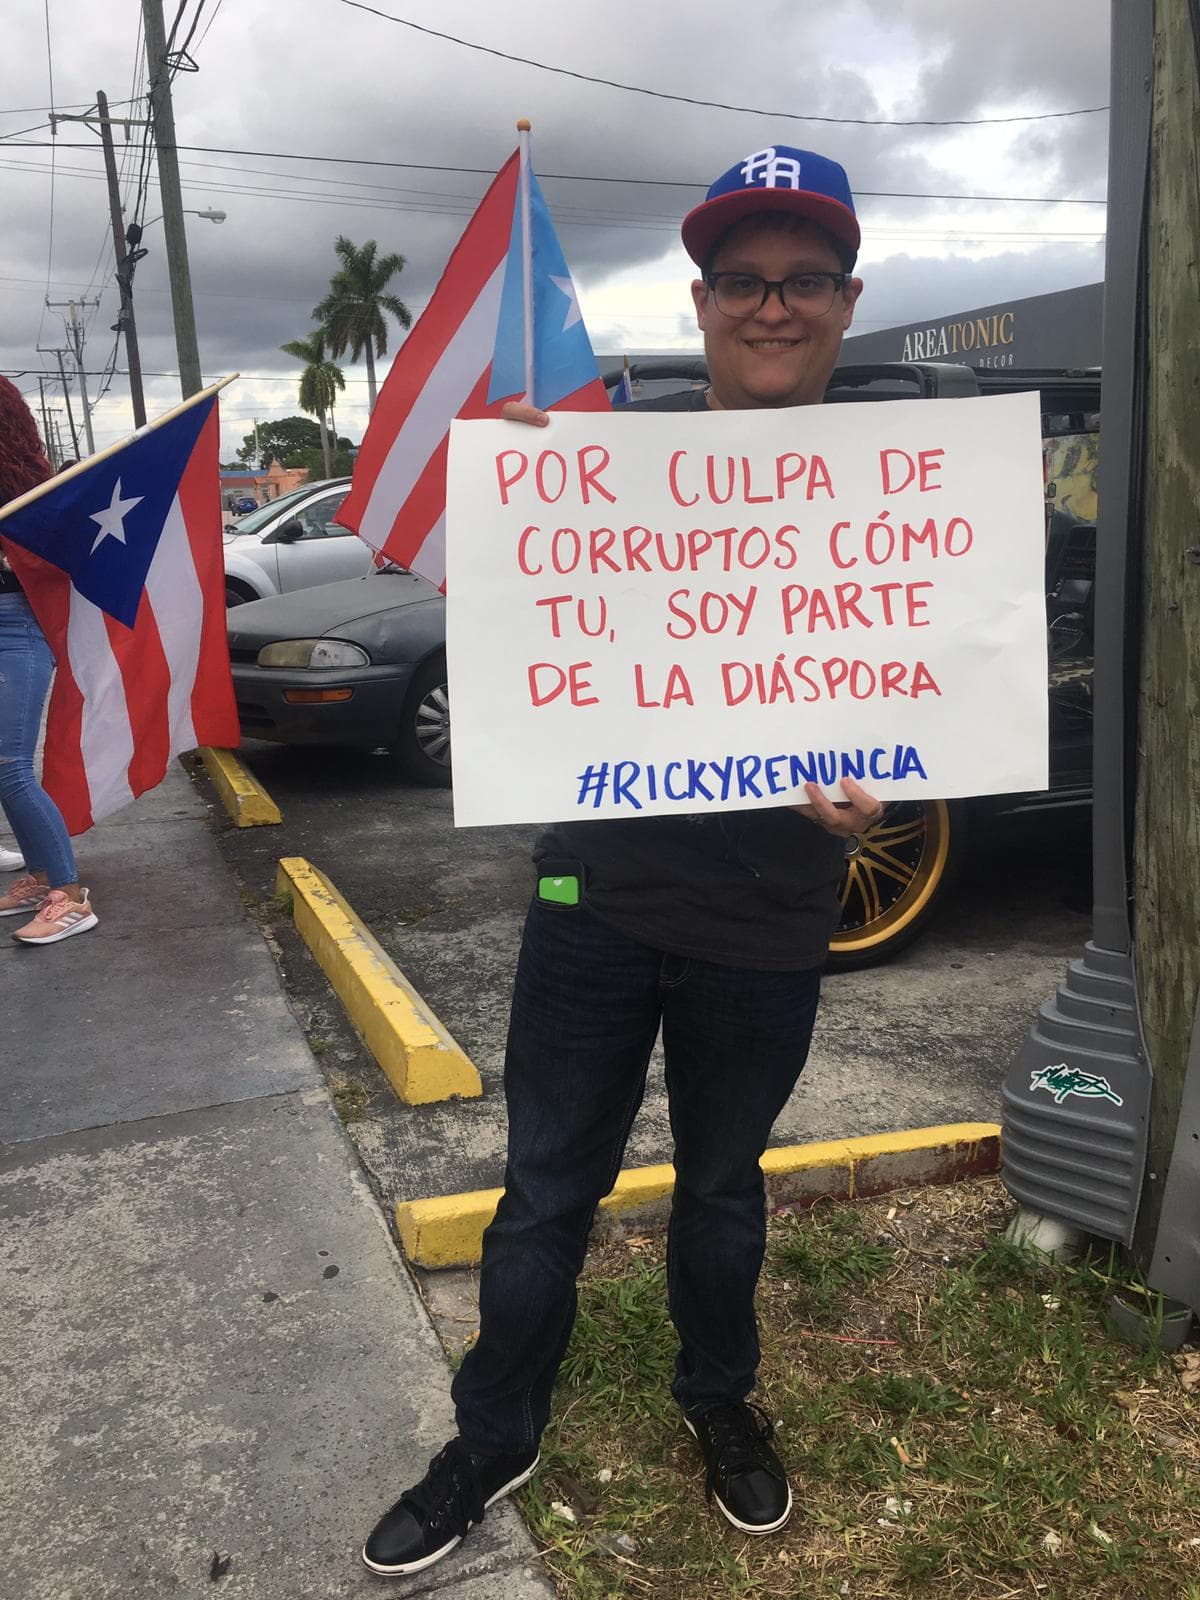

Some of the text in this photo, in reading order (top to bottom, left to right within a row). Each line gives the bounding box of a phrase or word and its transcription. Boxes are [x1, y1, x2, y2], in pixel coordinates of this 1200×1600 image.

[740, 147, 801, 190] PR
[901, 312, 1016, 362] AREATONIC
[979, 353, 1015, 369] DECOR
[495, 444, 945, 508] POR CULPA DE
[517, 510, 974, 577] CORRUPTOS CÓMO
[535, 580, 934, 643] TU, SOY PARTE
[527, 652, 942, 710] DE LA DIÁSPORA
[576, 744, 928, 811] #RICKYRENUNCIA
